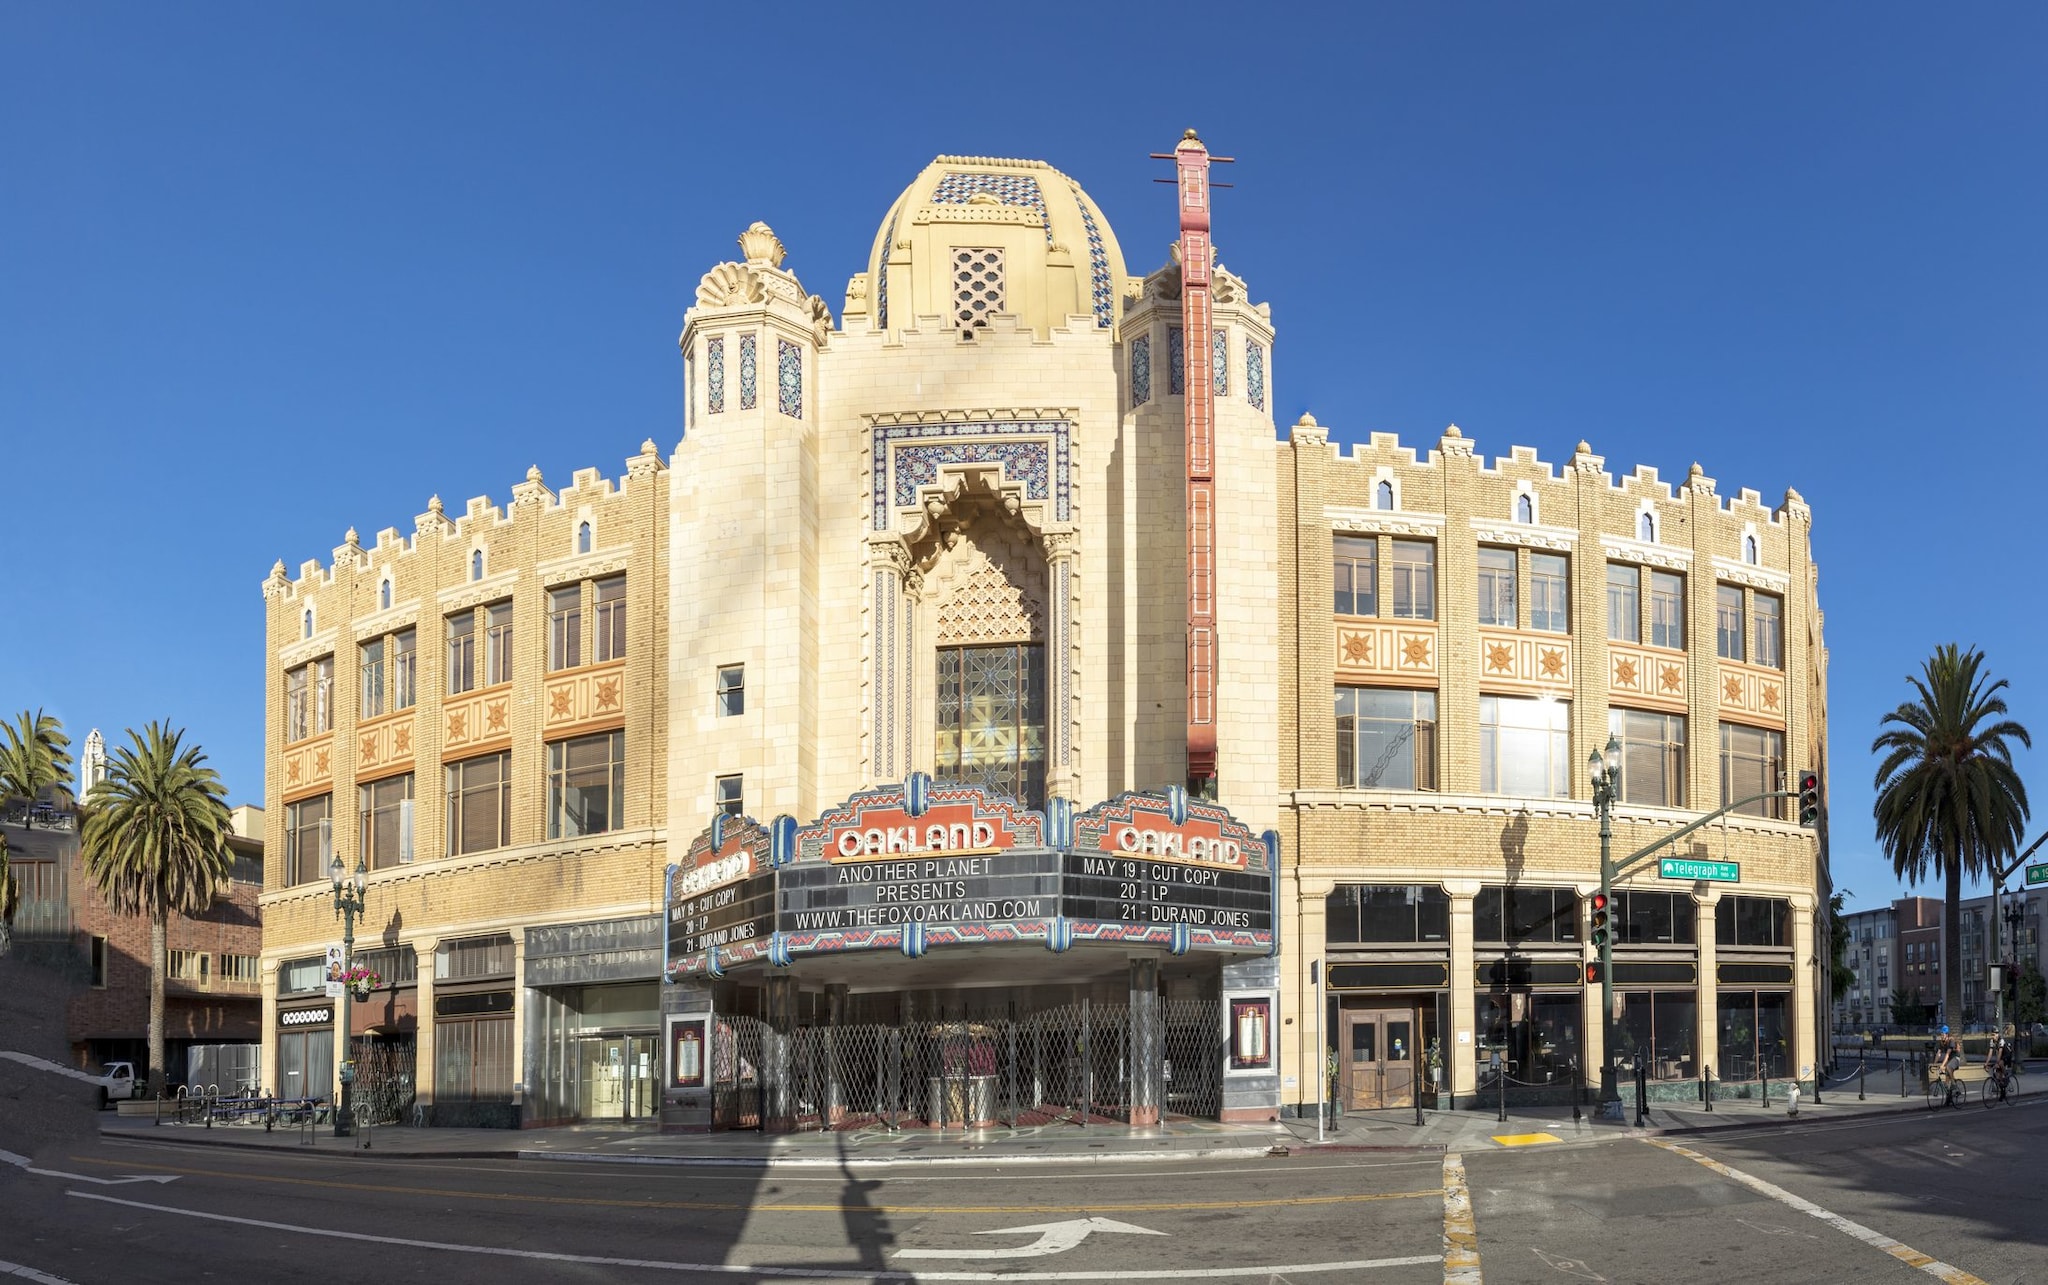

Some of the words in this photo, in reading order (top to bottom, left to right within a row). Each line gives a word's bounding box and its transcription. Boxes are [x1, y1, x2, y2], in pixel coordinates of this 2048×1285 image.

[838, 821, 995, 857] OAKLAND
[1116, 826, 1241, 864] OAKLAND
[838, 862, 917, 884] ANOTHER
[925, 858, 992, 878] PLANET
[1083, 858, 1117, 876] MAY
[1122, 862, 1136, 878] 19
[1151, 864, 1179, 882] CUT
[1184, 868, 1220, 886] COPY
[1674, 862, 1718, 878] Telegraph
[672, 905, 685, 921] MAY
[700, 895, 713, 912] CUT
[715, 888, 737, 907] COPY
[876, 880, 966, 903] PRESENTS
[1120, 883, 1136, 899] 20
[1152, 885, 1169, 901] LP
[686, 920, 694, 935] 20
[699, 916, 709, 930] LP
[795, 900, 1040, 930] WWW.THEFOXOAKLAND.COM
[1122, 904, 1136, 920] 21
[1151, 906, 1206, 924] DURAND
[1211, 911, 1249, 928] JONES
[531, 928, 560, 944] FOX
[569, 918, 659, 940] OAKLAND
[686, 939, 694, 953] 21
[699, 930, 728, 950] DURAND
[729, 922, 755, 943] JONES
[535, 955, 578, 970] OFFICE
[588, 950, 654, 966] BUILDING
[284, 1010, 328, 1024] EMPORIUM
